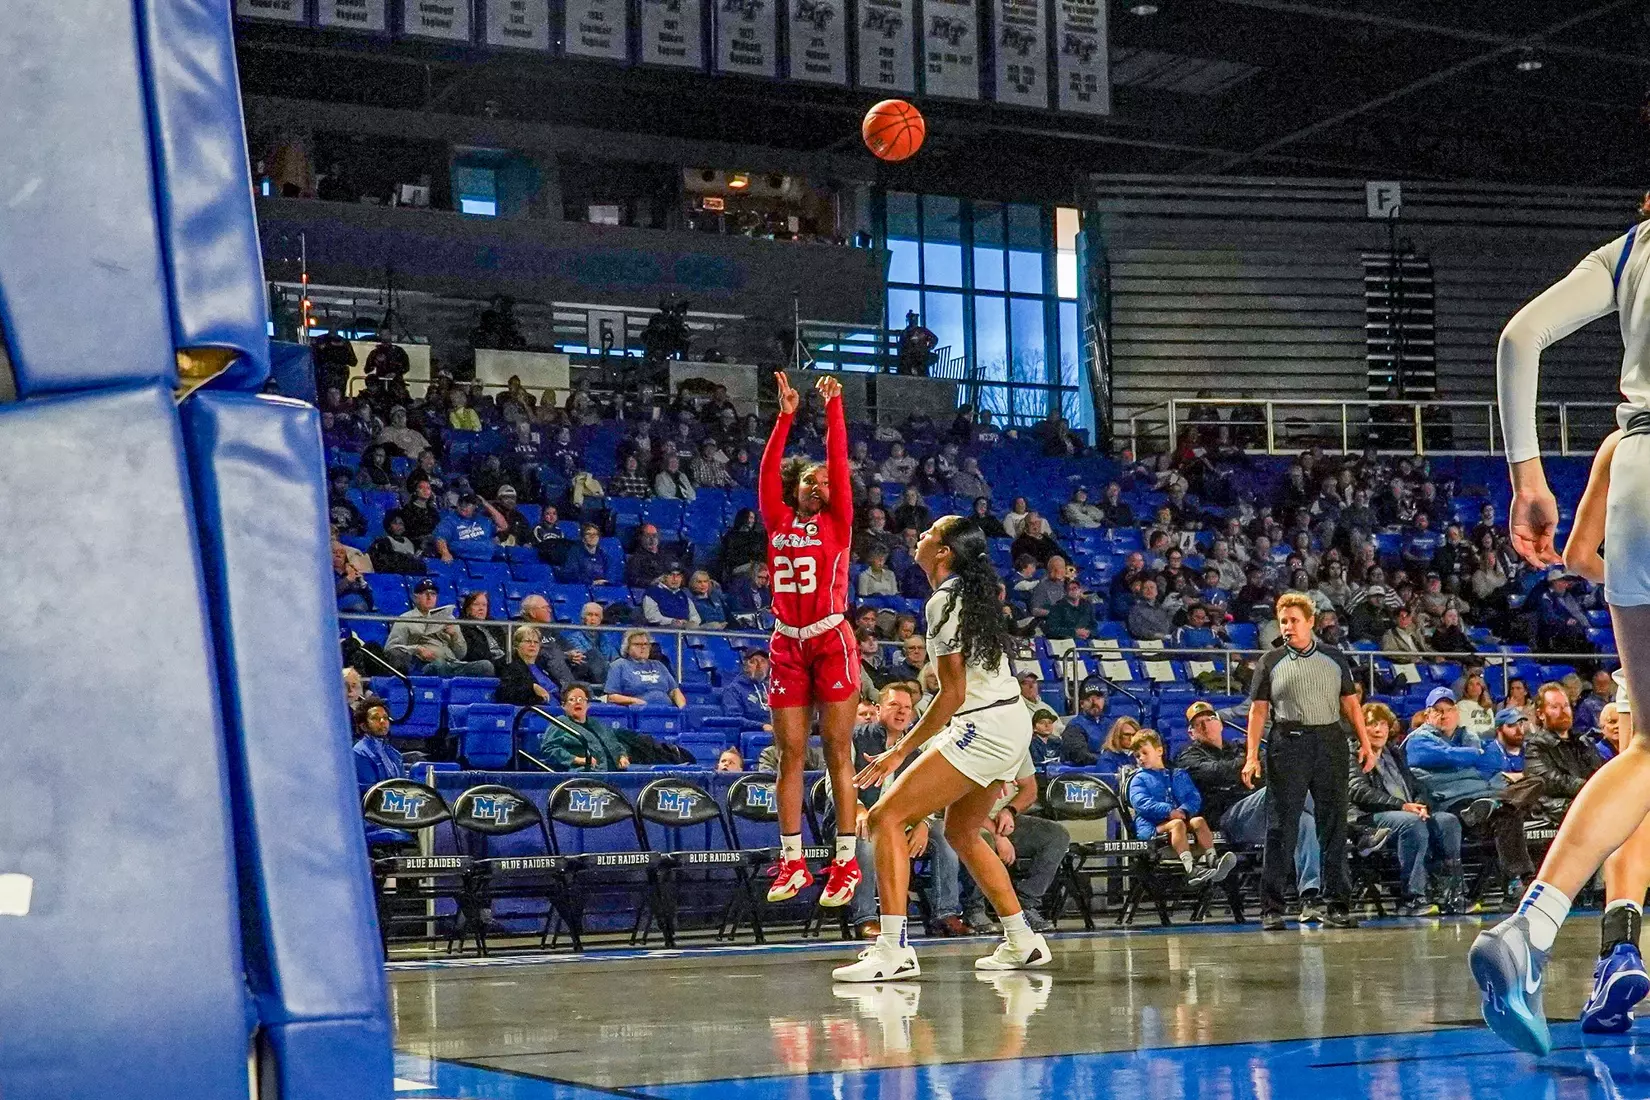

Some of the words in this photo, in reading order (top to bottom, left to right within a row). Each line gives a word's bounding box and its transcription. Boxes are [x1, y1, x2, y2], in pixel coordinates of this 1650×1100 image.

[1378, 188, 1391, 210] F
[773, 555, 817, 594] 23
[381, 789, 426, 819] MT
[568, 789, 612, 819] MT
[656, 789, 697, 819] MT
[1064, 781, 1099, 809] MT
[471, 796, 515, 825] MT
[689, 853, 708, 863] BLUE
[709, 852, 740, 863] RAIDERS
[1104, 842, 1121, 852] BLUE
[1122, 841, 1148, 851] RAIDERS
[406, 858, 427, 868] BLUE
[428, 857, 462, 868] RAIDERS
[501, 860, 521, 870] BLUE
[523, 858, 556, 869] RAIDERS
[597, 855, 616, 865] BLUE
[618, 854, 650, 864] RAIDERS
